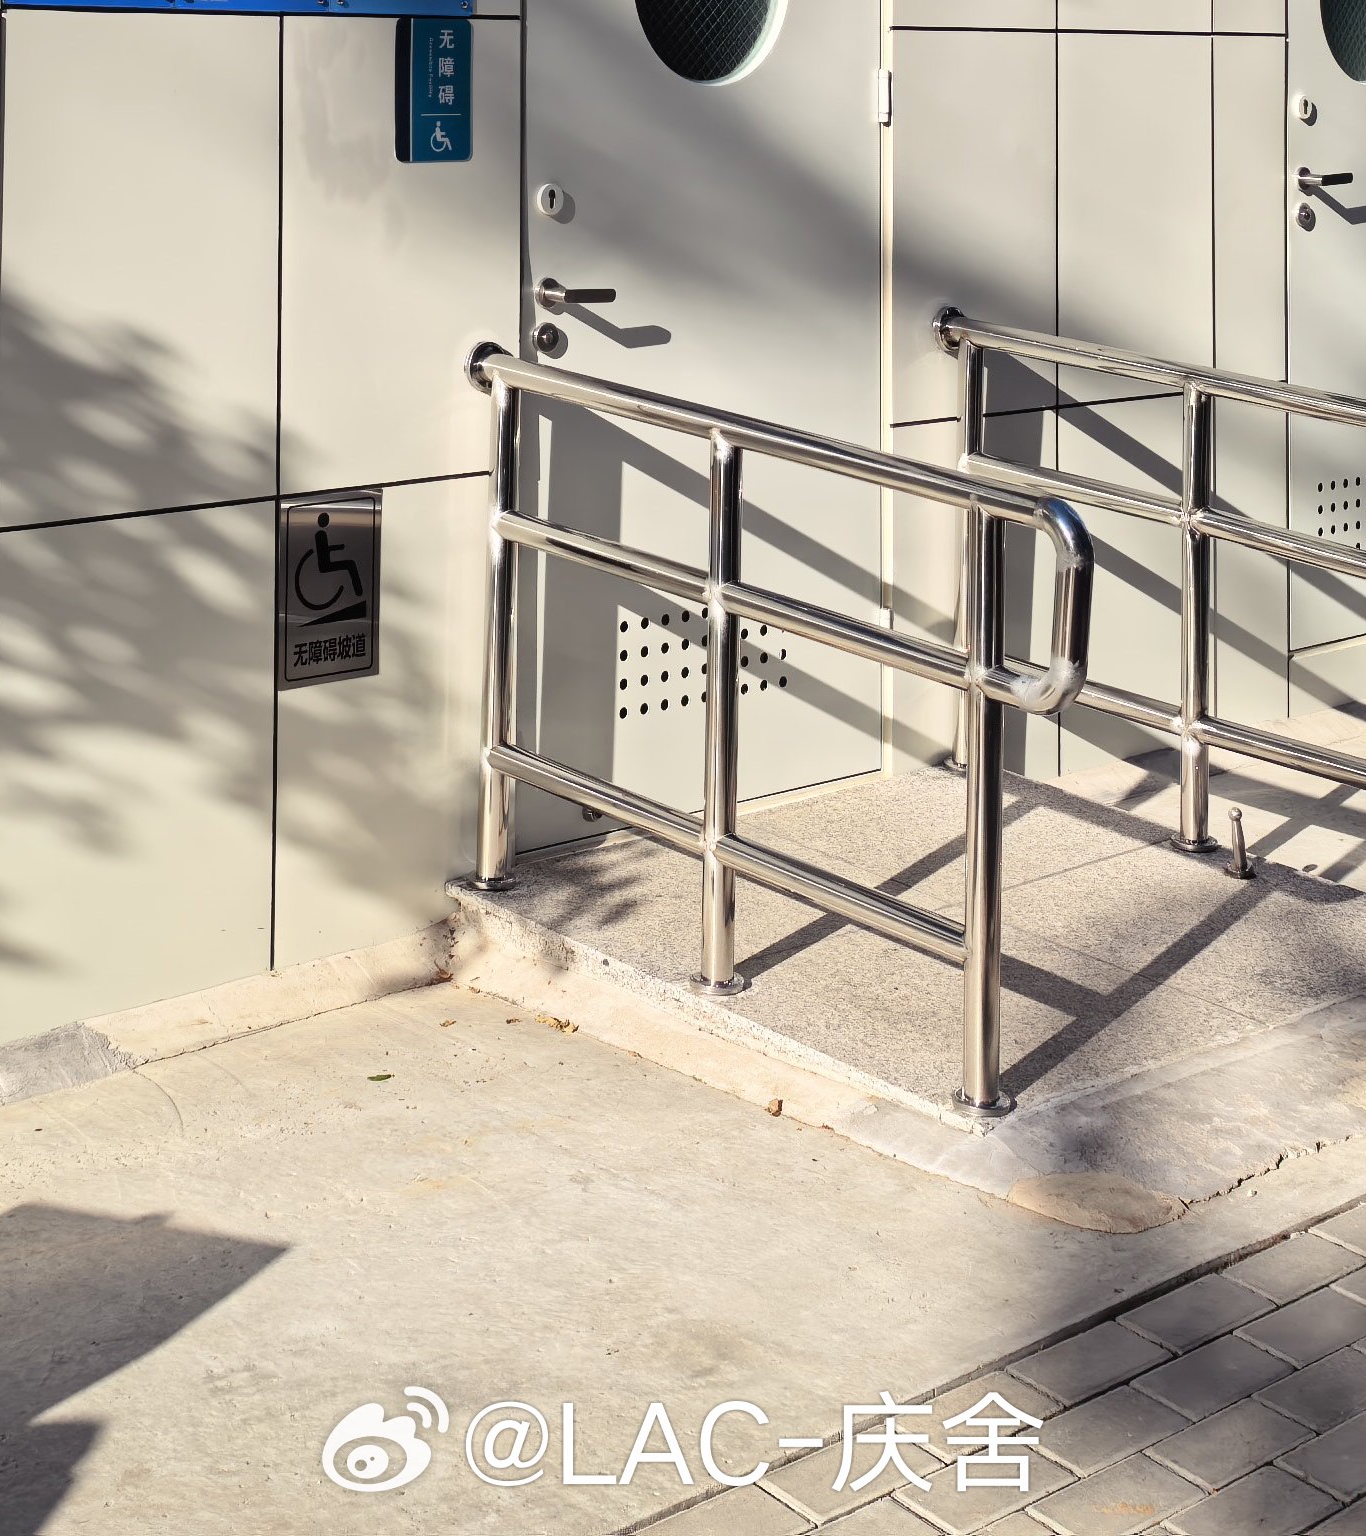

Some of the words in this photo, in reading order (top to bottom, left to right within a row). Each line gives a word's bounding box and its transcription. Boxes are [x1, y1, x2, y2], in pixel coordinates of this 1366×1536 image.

[438, 29, 455, 106] 无障碍
[293, 633, 367, 668] 无障碍坡道
